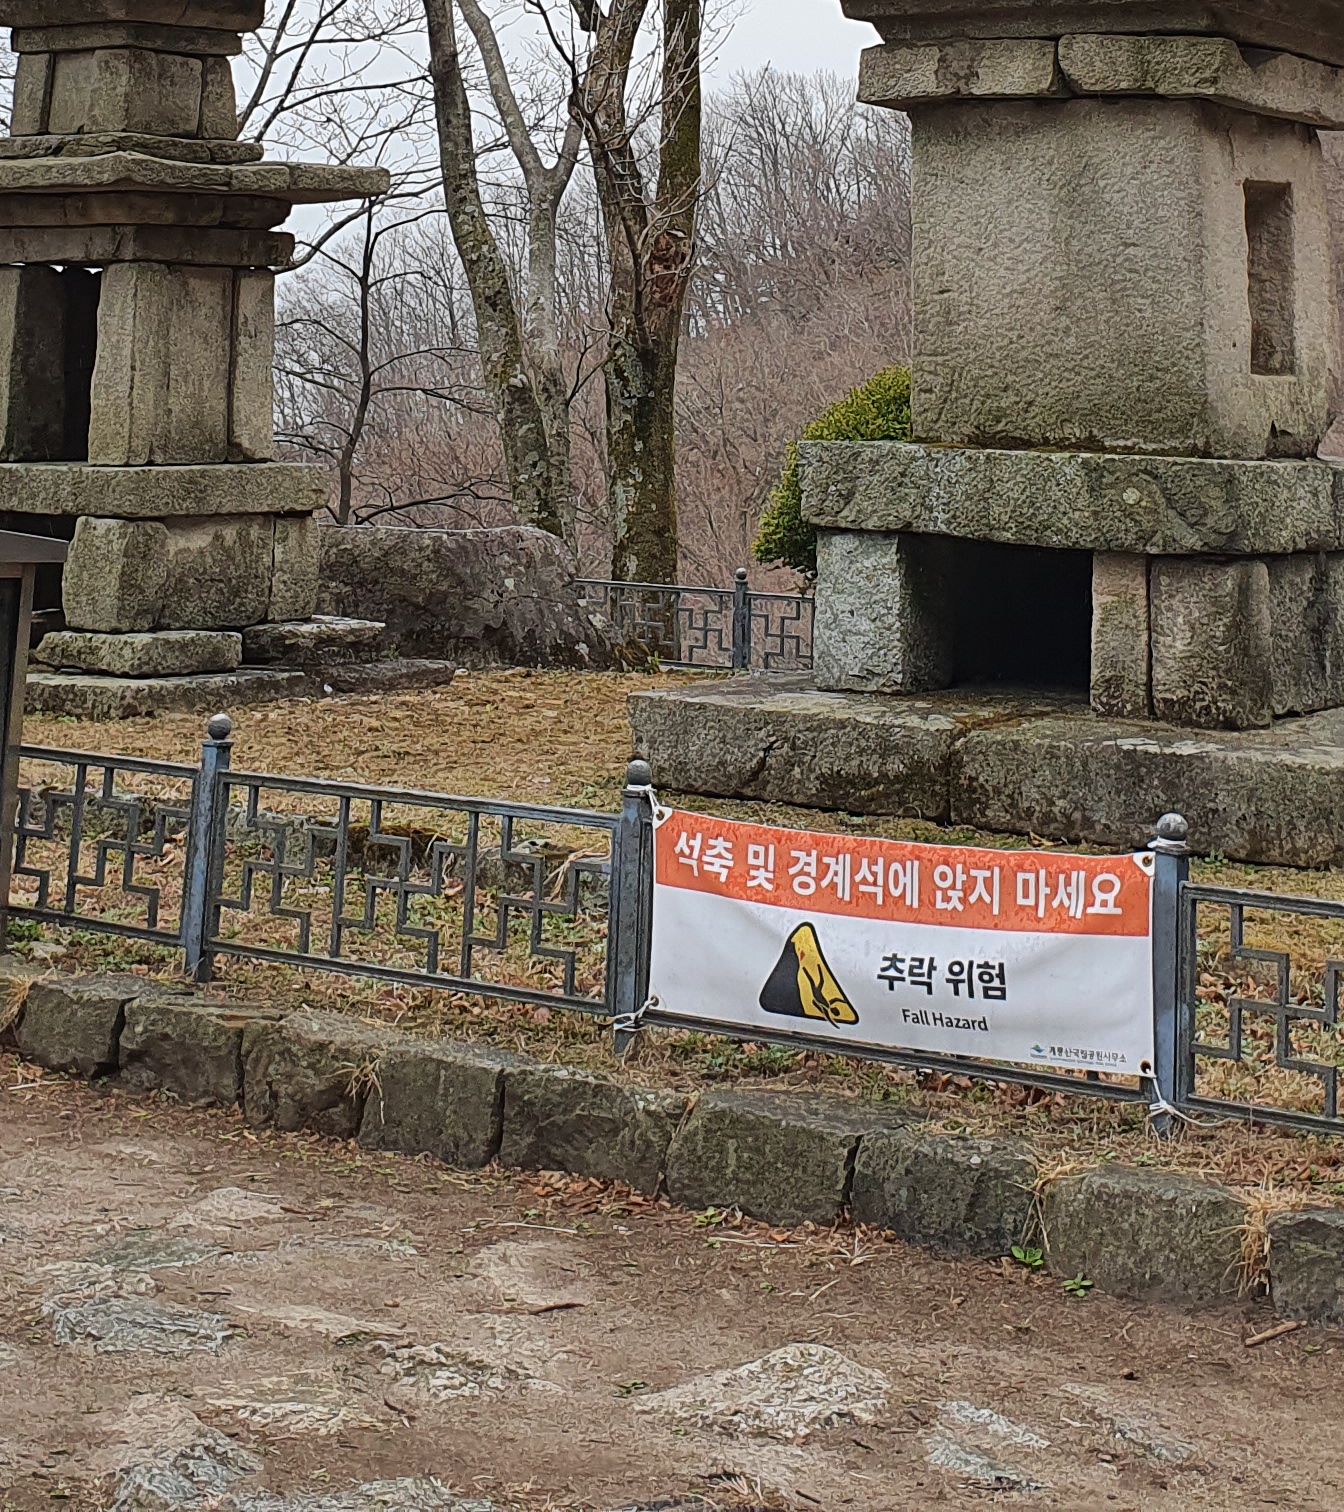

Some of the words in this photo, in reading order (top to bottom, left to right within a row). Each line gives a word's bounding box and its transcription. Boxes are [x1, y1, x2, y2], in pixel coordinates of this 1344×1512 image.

[673, 830, 735, 883] 석축
[746, 843, 775, 891] 및
[787, 848, 921, 909] 경계석에
[933, 863, 1000, 916] 앉지
[1016, 867, 1123, 920] 마세요
[876, 953, 938, 996] 추락
[945, 960, 1007, 1001] 위험
[901, 1008, 931, 1027] Fall
[932, 1011, 989, 1032] Hazard
